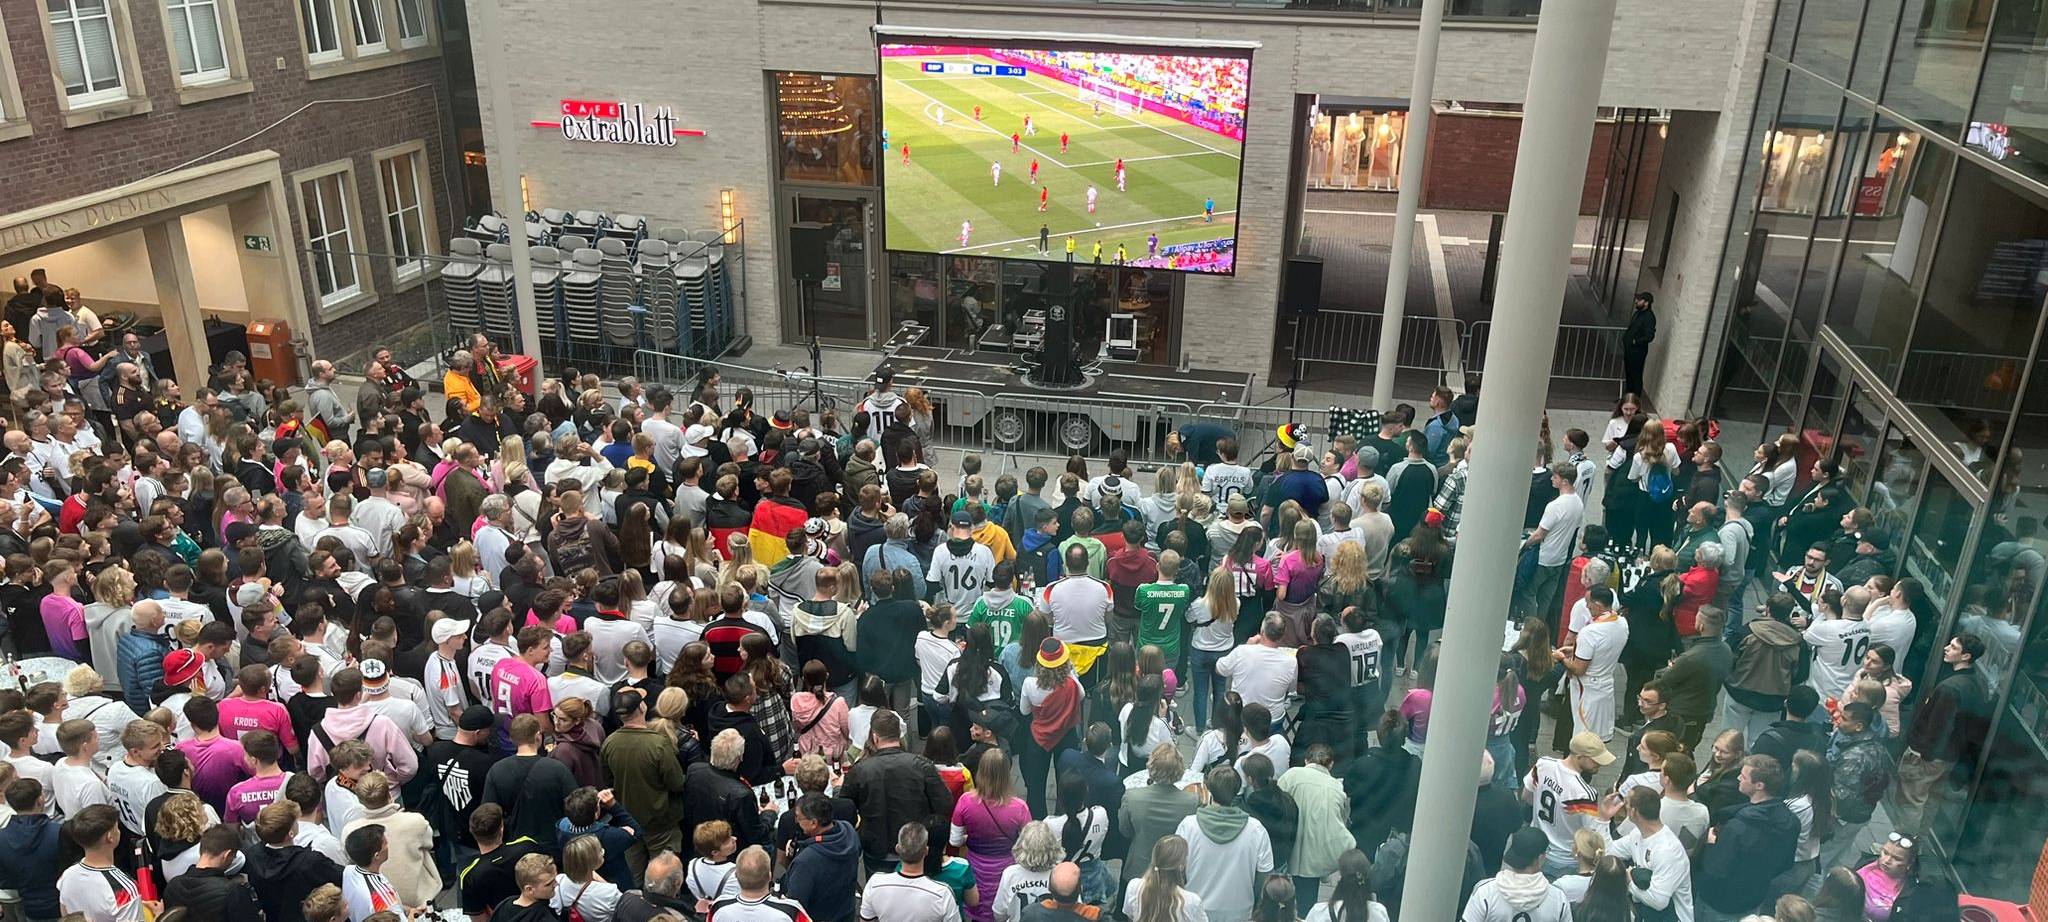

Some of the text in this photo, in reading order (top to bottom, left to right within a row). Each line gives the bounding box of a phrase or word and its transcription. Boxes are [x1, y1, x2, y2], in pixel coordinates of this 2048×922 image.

[562, 103, 616, 115] CAFE
[562, 102, 680, 146] extrablatt
[948, 564, 978, 591] 16
[1158, 603, 1175, 630] 7
[991, 620, 1012, 648] 19
[1841, 635, 1870, 667] 10
[497, 680, 513, 716] 9
[233, 715, 259, 728] KROOS
[114, 798, 139, 826] 15
[1537, 789, 1557, 825] 9
